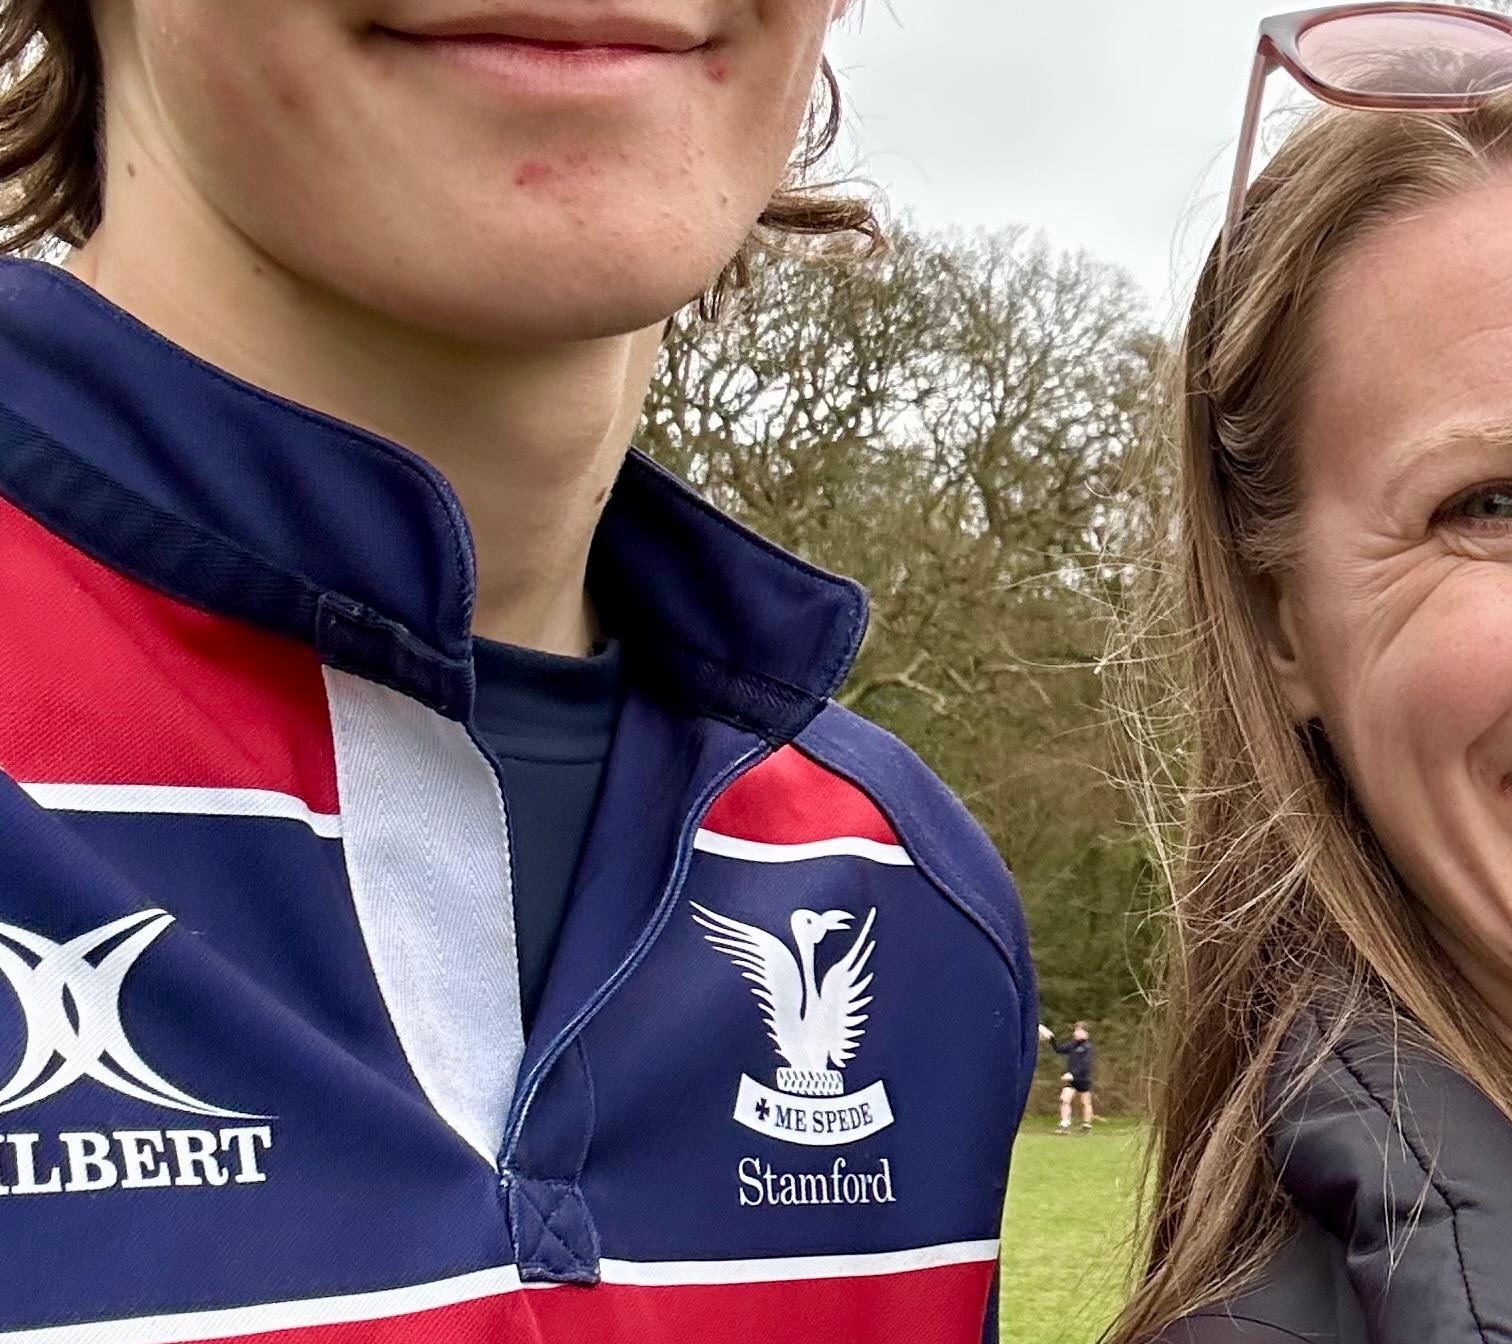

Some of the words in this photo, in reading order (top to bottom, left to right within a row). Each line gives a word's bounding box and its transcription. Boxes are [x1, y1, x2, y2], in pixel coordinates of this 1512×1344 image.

[775, 1105, 806, 1132] ME
[812, 1103, 873, 1133] SPEDE
[738, 1158, 896, 1206] Stamford
